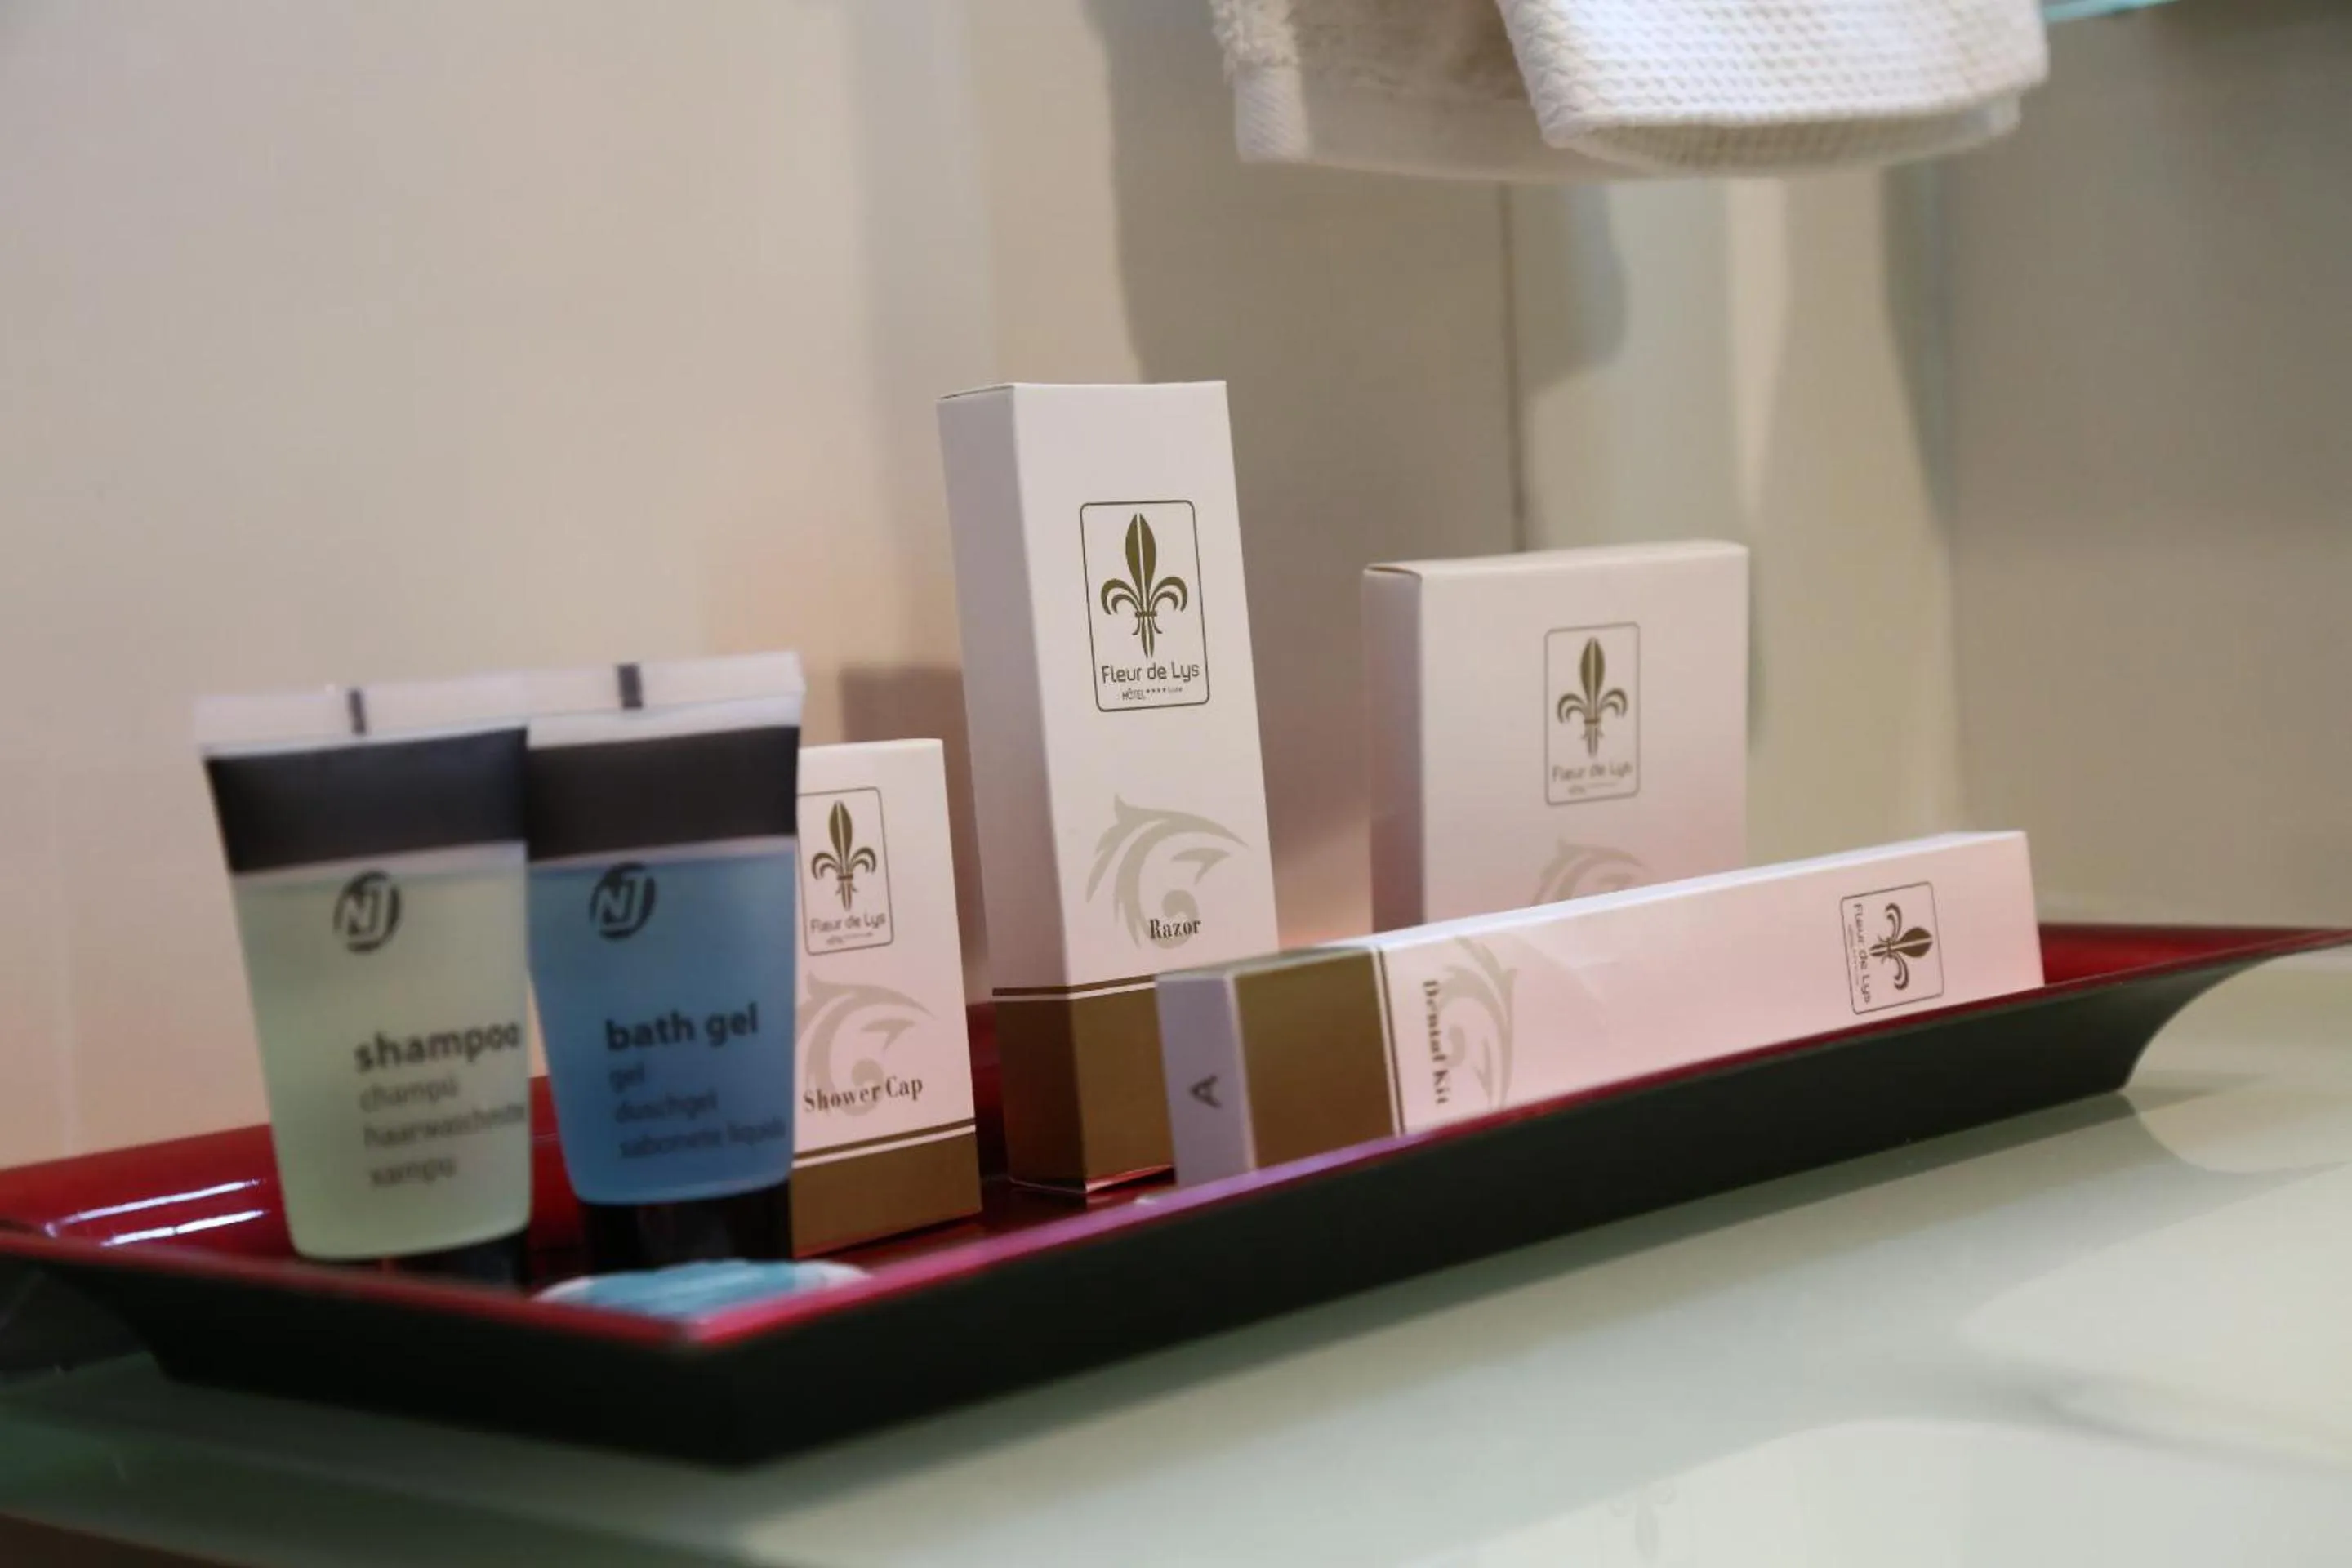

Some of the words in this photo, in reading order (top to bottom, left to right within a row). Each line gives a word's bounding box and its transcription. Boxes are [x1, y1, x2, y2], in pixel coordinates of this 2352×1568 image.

[1102, 665, 1142, 683] Fleur
[1147, 662, 1167, 679] de
[1171, 660, 1200, 682] Lys
[1149, 918, 1201, 940] Razor
[1860, 974, 1871, 1004] Lys
[605, 1009, 695, 1052] bath
[706, 1001, 759, 1048] gel
[1423, 979, 1447, 1062] Dental
[354, 1022, 520, 1076] shampoo
[609, 1064, 645, 1094] gel
[804, 1083, 880, 1113] Shower
[885, 1076, 923, 1100] Cap
[1189, 1073, 1222, 1109] A
[1432, 1068, 1450, 1104] Kit
